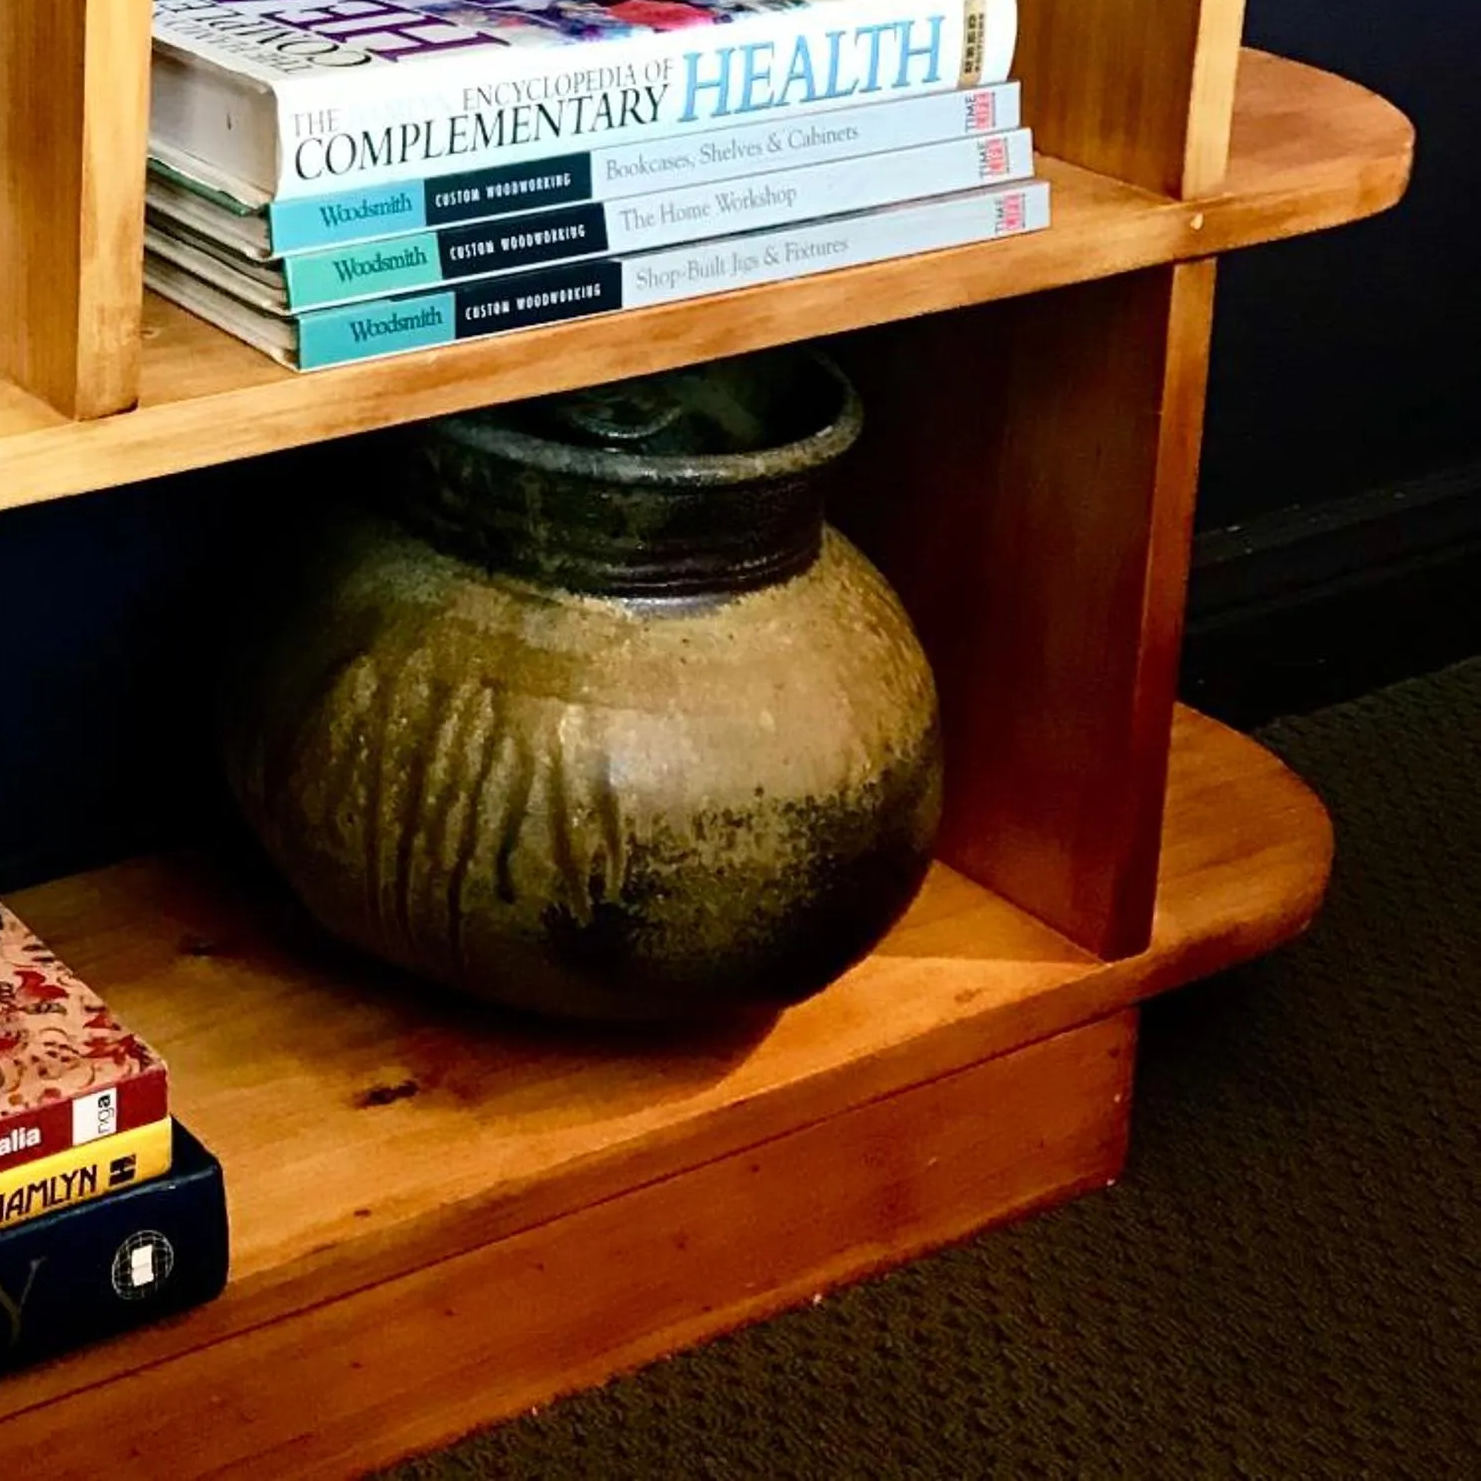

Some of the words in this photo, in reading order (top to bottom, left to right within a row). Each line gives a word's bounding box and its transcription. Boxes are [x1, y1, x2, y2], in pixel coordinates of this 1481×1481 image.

[294, 108, 340, 138] THE
[463, 62, 638, 112] ENCYCLOPEDIA
[644, 57, 675, 83] OF
[295, 84, 670, 181] COMPLEMENTARY
[677, 15, 946, 123] HEALTH
[965, 94, 976, 131] TIME
[319, 193, 413, 227] Woodsmith
[435, 189, 480, 209] CUSTOM
[486, 172, 571, 200] WOODWORKING
[606, 154, 696, 181] Bookcases,
[700, 141, 764, 162] Shelves
[767, 132, 782, 153] &
[787, 125, 860, 149] Cabinets
[333, 247, 428, 283] Woodsmith
[450, 241, 494, 261] CUSTOM
[500, 223, 586, 251] WOODWORKING
[619, 209, 655, 231] The
[661, 200, 710, 225] Home
[715, 185, 797, 214] Workshop
[350, 306, 443, 344] Woodsmith
[465, 301, 509, 321] CUSTOM
[516, 283, 601, 310] WOODWORKING
[636, 254, 726, 291] Shop-Built
[730, 252, 759, 279] Jigs
[763, 246, 780, 266] &
[784, 237, 849, 263] Fixtures
[97, 1094, 115, 1134] nga
